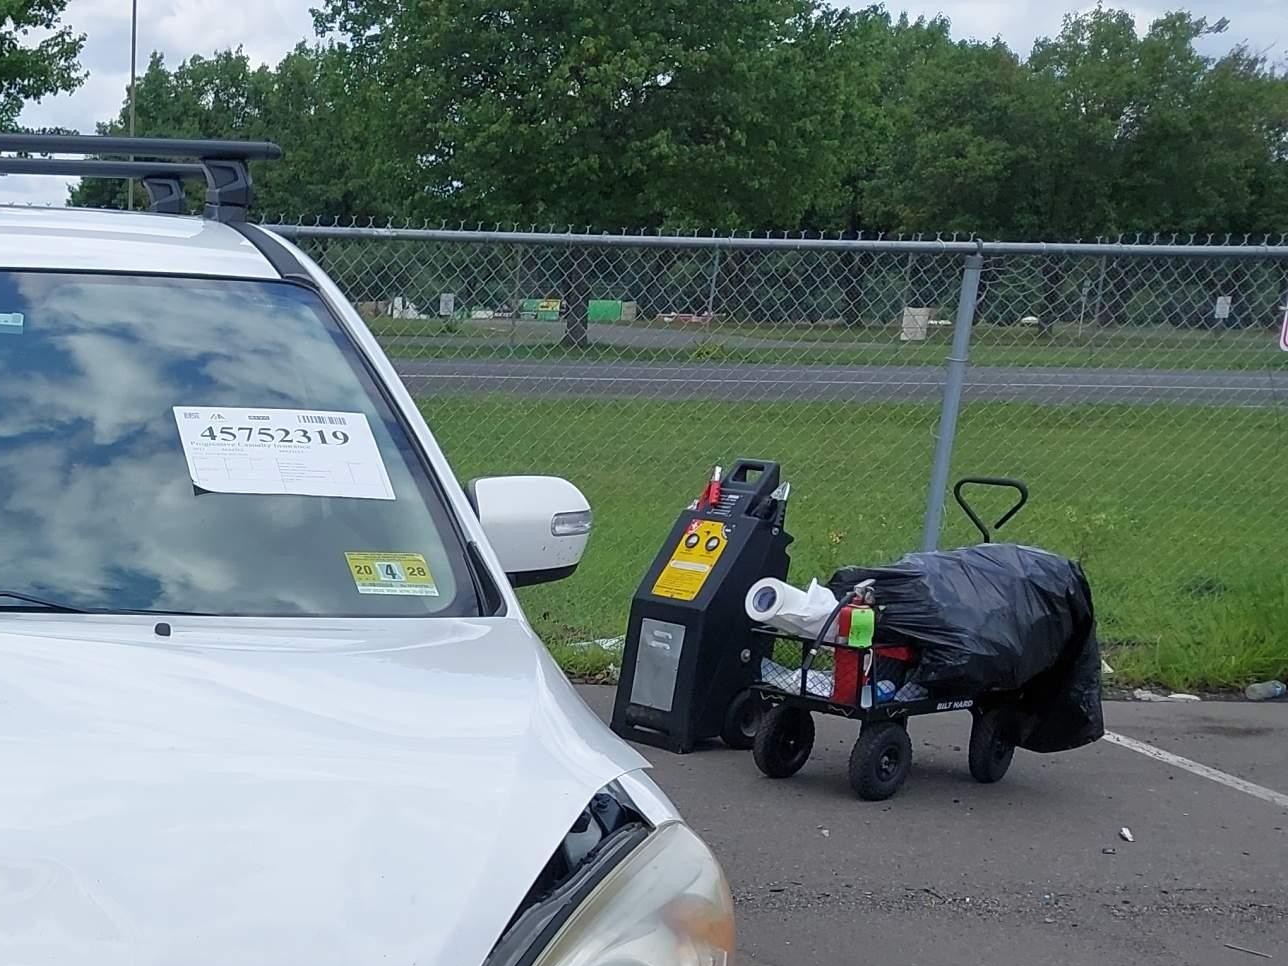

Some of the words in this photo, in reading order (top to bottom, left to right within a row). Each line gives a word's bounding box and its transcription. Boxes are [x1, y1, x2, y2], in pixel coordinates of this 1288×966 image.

[200, 426, 349, 446] 45752319
[354, 564, 373, 575] 20
[385, 564, 397, 580] 4
